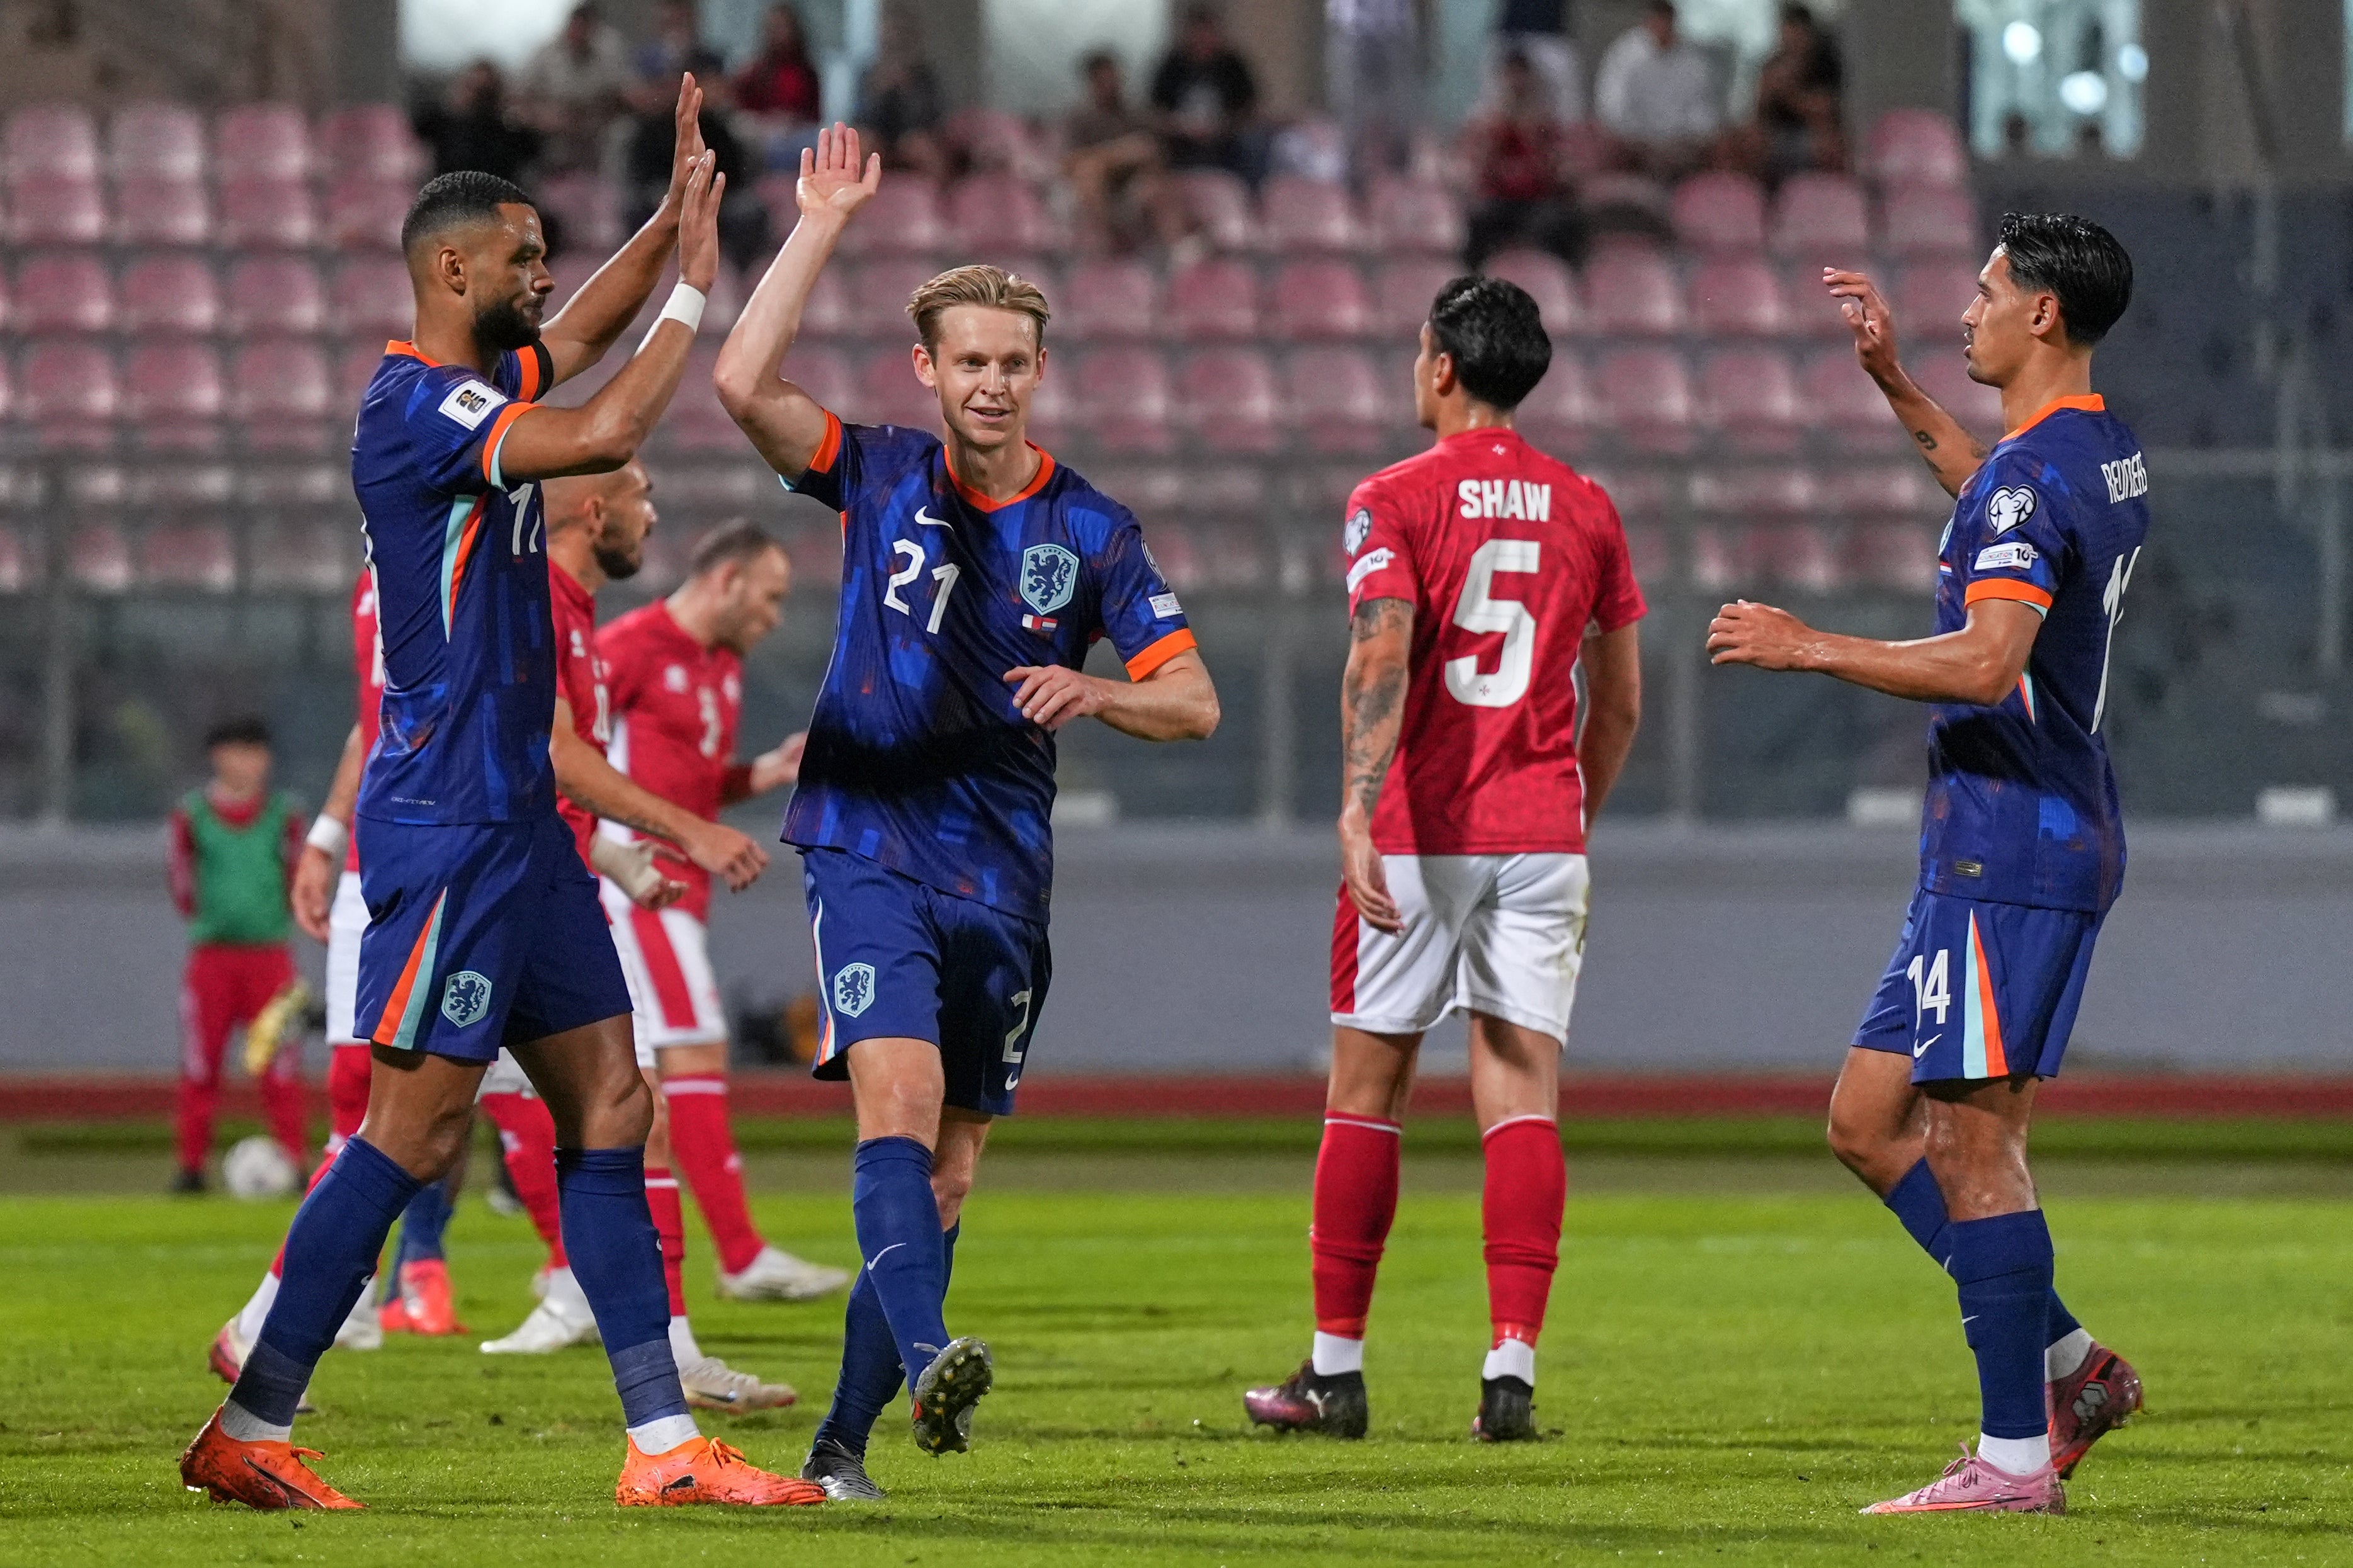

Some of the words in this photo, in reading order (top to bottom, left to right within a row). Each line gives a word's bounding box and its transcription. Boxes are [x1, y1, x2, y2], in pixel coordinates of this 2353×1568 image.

[1458, 479, 1551, 522] SHAW
[883, 538, 960, 635] 21
[1444, 539, 1541, 708] 5
[1907, 949, 1951, 1030] 14
